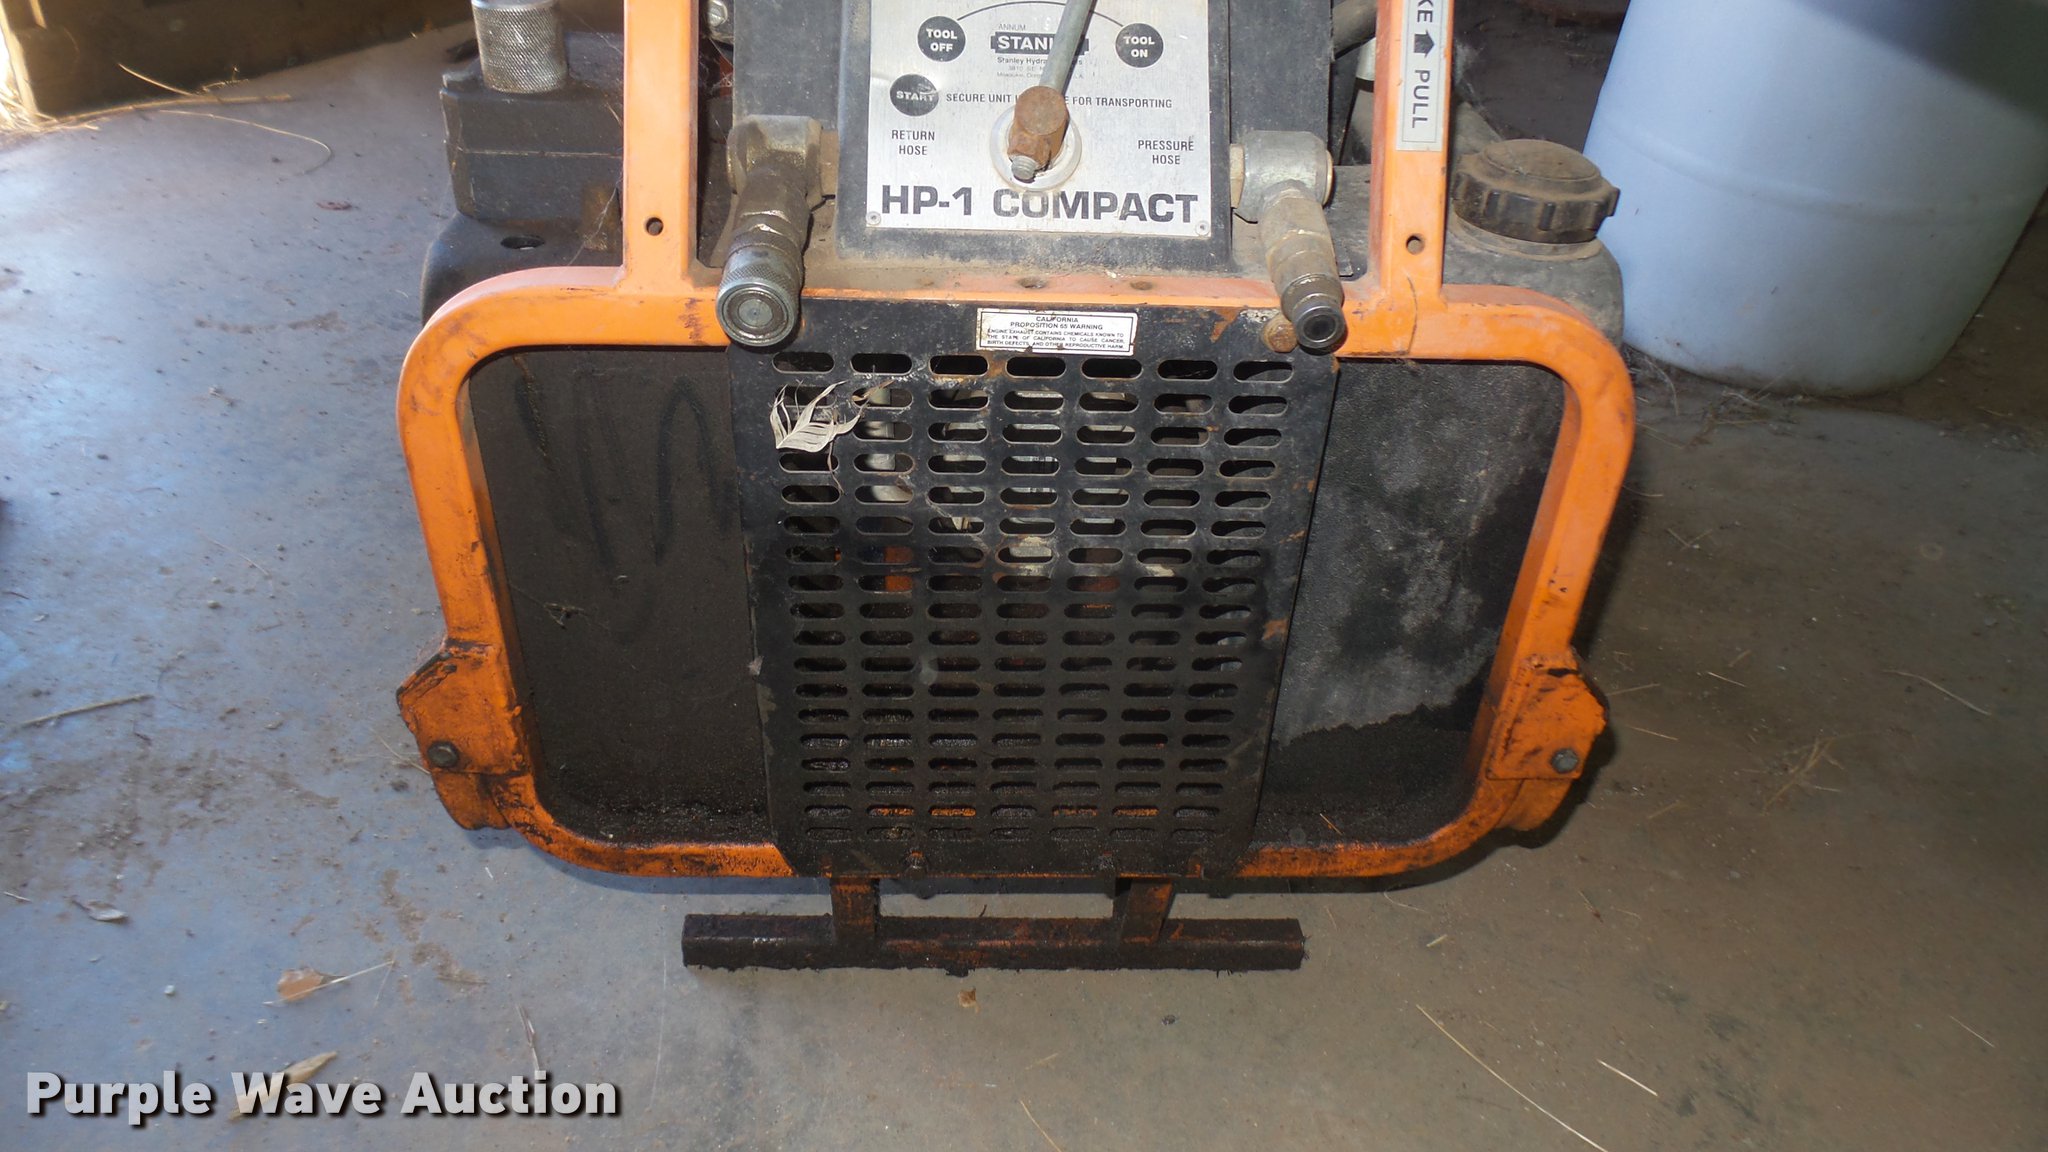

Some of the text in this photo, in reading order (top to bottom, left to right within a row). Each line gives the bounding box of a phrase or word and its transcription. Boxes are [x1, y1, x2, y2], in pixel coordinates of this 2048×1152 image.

[925, 28, 958, 40] TOOL
[997, 35, 1055, 51] STAN
[1123, 36, 1155, 46] TOOL
[930, 43, 953, 53] OFF
[1130, 49, 1149, 58] ON
[997, 56, 1024, 66] Stanley
[896, 90, 935, 102] START
[946, 93, 986, 103] SECURE
[988, 93, 1012, 104] UNIT
[1411, 69, 1431, 129] PULL
[1072, 96, 1093, 106] FOR
[1095, 97, 1173, 109] TRANSPORTING
[891, 129, 936, 142] RETURN
[898, 145, 928, 156] HOSE
[1137, 139, 1195, 151] PRESSURE
[1152, 154, 1181, 165] HOSE
[881, 184, 1199, 223] HP-1 COMPACT
